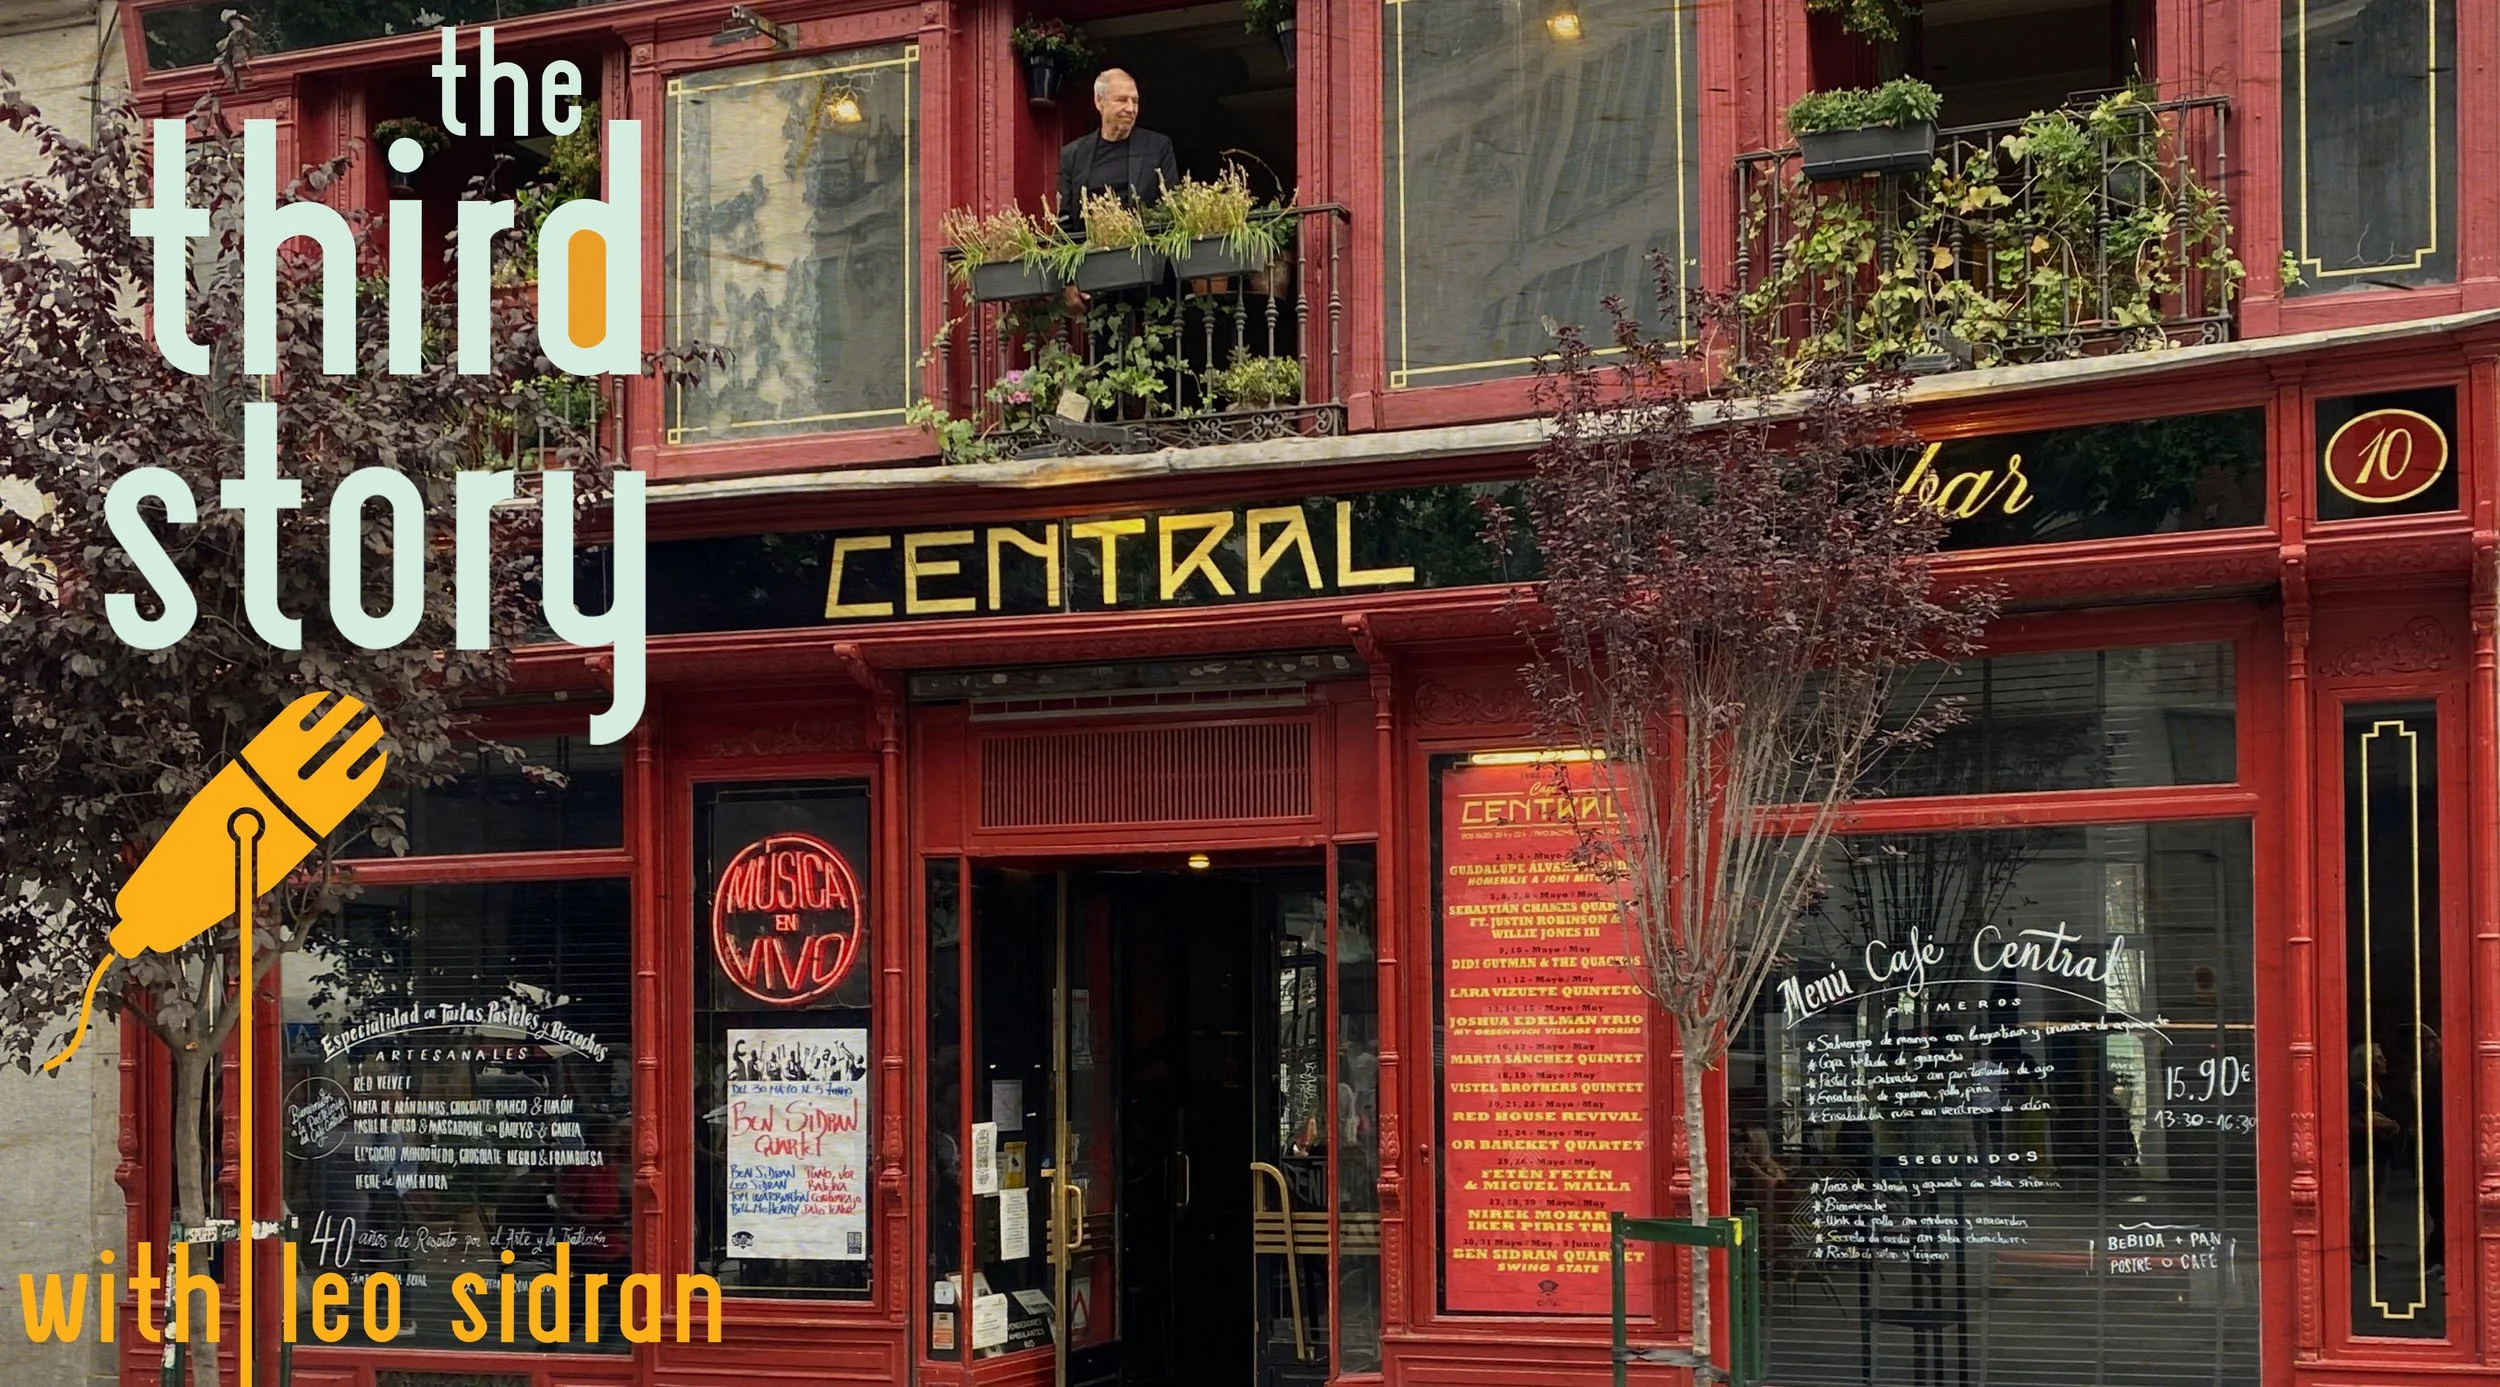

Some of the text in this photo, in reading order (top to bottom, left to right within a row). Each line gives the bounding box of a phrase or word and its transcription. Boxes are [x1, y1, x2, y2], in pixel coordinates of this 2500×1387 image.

[2358, 427, 2413, 484] 10
[825, 501, 1414, 618] CENTRAL
[1462, 796, 1627, 824] CENTRAL
[1449, 863, 1525, 876] GUADALUPE
[1468, 876, 1528, 886] HOMENAJE
[1531, 875, 1539, 884] A
[1542, 874, 1570, 884] JONI
[1448, 902, 1519, 915] SEBASTIÁN
[775, 913, 799, 931] EN
[1490, 916, 1534, 929] JUSTIN
[1536, 914, 1607, 925] ROBINSON
[1491, 927, 1600, 940] WILLIE JONES III
[1973, 920, 2125, 985] Central
[725, 932, 849, 991] VIVO
[1482, 957, 1537, 968] GUTMAN
[1539, 957, 1549, 968] &
[1551, 956, 1577, 967] THE
[1449, 985, 1643, 998] LARA VIZUETE QUINTETO
[1449, 1014, 1643, 1028] JOSHUA EDELMAN TRIO
[321, 1000, 419, 1057] Especialidad
[551, 1021, 609, 1062] Bizcochos
[1453, 1028, 1471, 1036] MY
[1544, 1027, 1591, 1035] VILLAGE
[1594, 1027, 1641, 1035] STORIES
[375, 1047, 528, 1062] ARTESANALES
[1450, 1051, 1644, 1066] MARTA SÁNCHEZ QUINTET
[353, 1075, 412, 1092] RED VELVET
[1450, 1082, 1645, 1095] VISTEL BROTHERS QUINTET
[353, 1100, 378, 1114] TARTA
[1452, 1111, 1643, 1122] RED HOUSE REVIVAL
[1451, 1139, 1645, 1153] OR BAREKET QUARTET
[1548, 1167, 1613, 1180] FETÉN
[1463, 1180, 1632, 1192] & MIGUEL MALLA
[1467, 1208, 1609, 1221] NIREK MOKAR
[1467, 1220, 1575, 1232] IKER PIRIS
[310, 1210, 356, 1268] 40
[394, 1226, 411, 1249] de
[2190, 1231, 2222, 1247] PAN
[1452, 1248, 1645, 1263] BEN SIDRAN QUARET
[1496, 1262, 1600, 1273] SWING STATE
[2110, 1257, 2153, 1274] POSTRE
